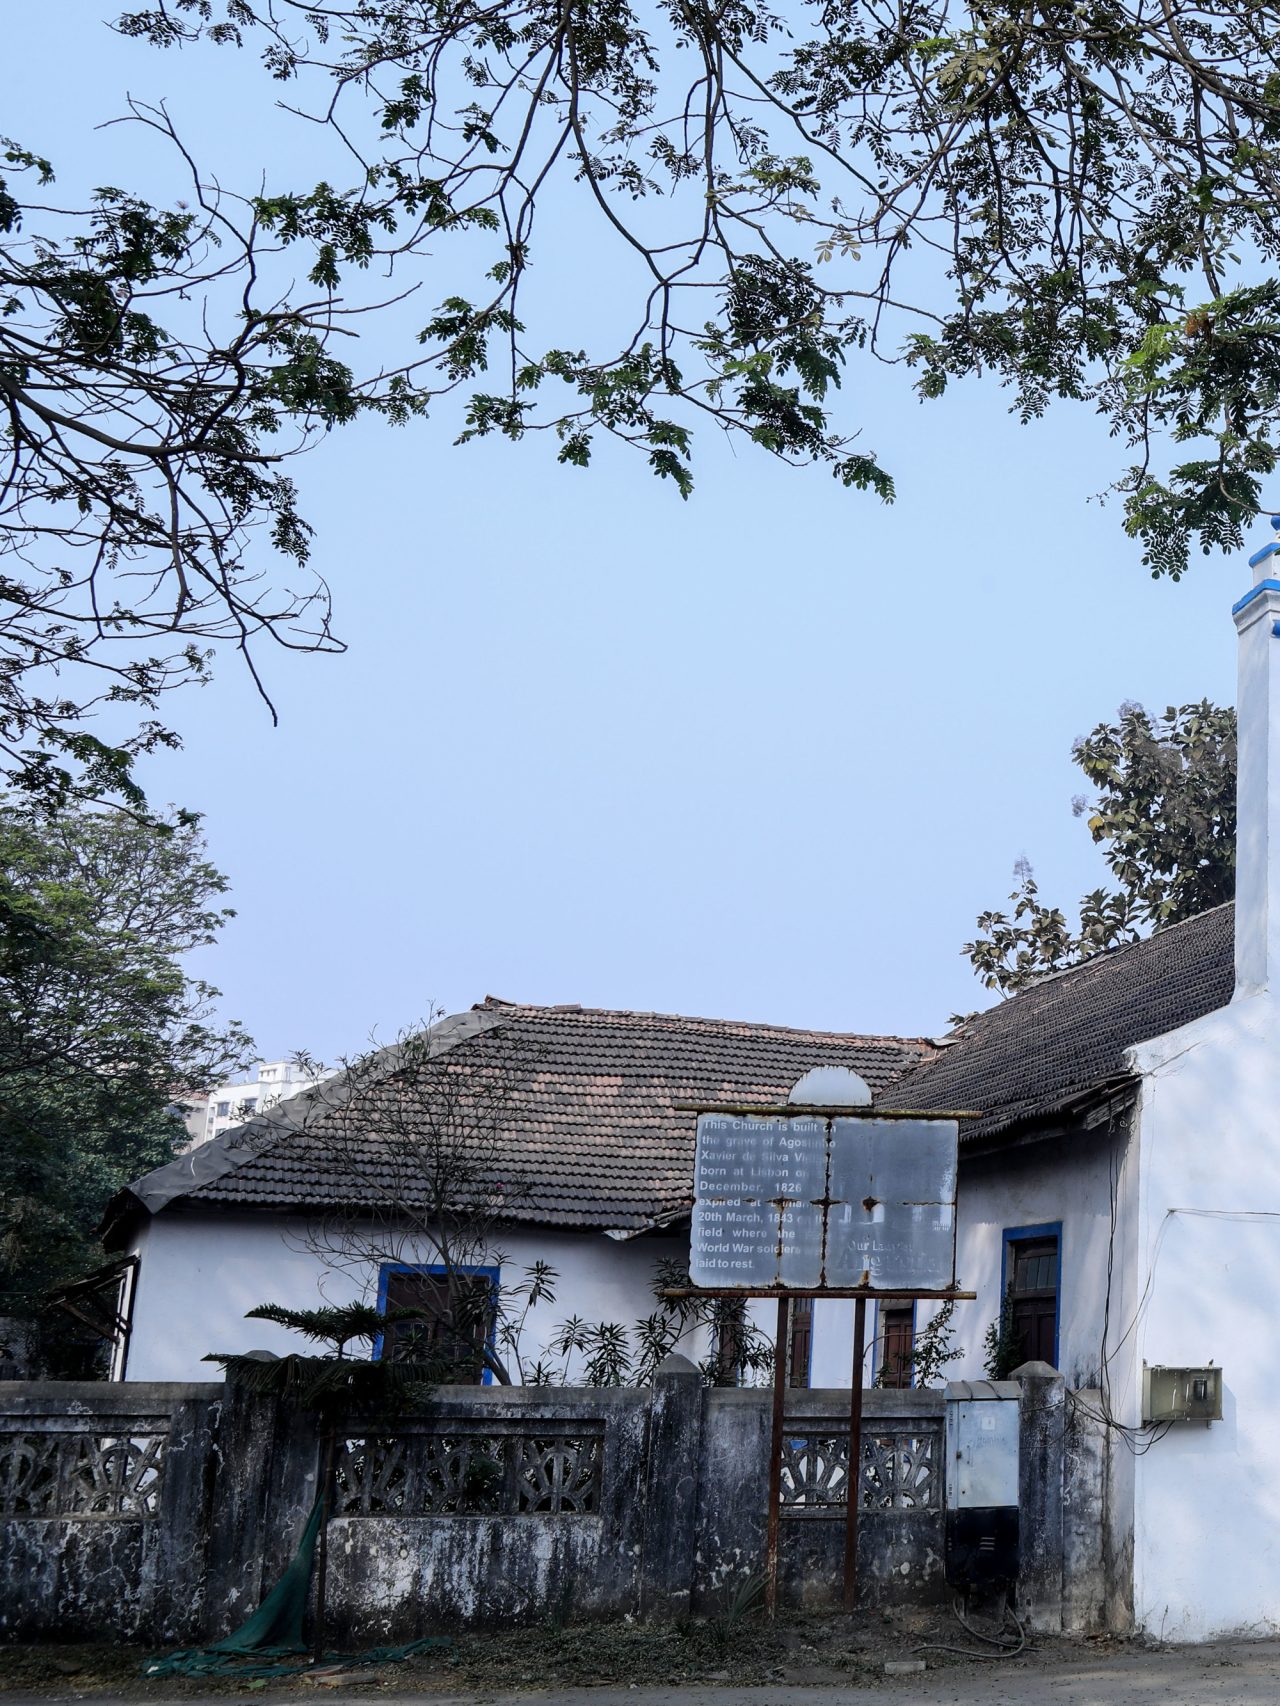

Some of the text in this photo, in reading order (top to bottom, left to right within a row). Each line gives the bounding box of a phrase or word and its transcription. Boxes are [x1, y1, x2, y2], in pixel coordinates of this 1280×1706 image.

[704, 1120, 727, 1129] This
[732, 1121, 773, 1131] Church
[778, 1122, 788, 1132] is
[793, 1122, 818, 1133] built
[702, 1135, 720, 1145] the
[762, 1136, 774, 1146] of
[701, 1150, 737, 1160] Xavier
[700, 1166, 727, 1176] born
[733, 1167, 744, 1176] at
[751, 1167, 789, 1177] Lisbon
[700, 1181, 764, 1193] December,
[775, 1182, 802, 1193] 1826
[699, 1197, 741, 1208] expired
[698, 1212, 722, 1222] 20th
[726, 1212, 764, 1224] March,
[768, 1213, 793, 1223] 1843
[698, 1228, 723, 1237] field
[732, 1228, 767, 1239] where
[777, 1229, 796, 1239] the
[696, 1243, 730, 1253] World
[732, 1243, 754, 1253] War
[696, 1258, 716, 1268] laid
[717, 1259, 729, 1268] to
